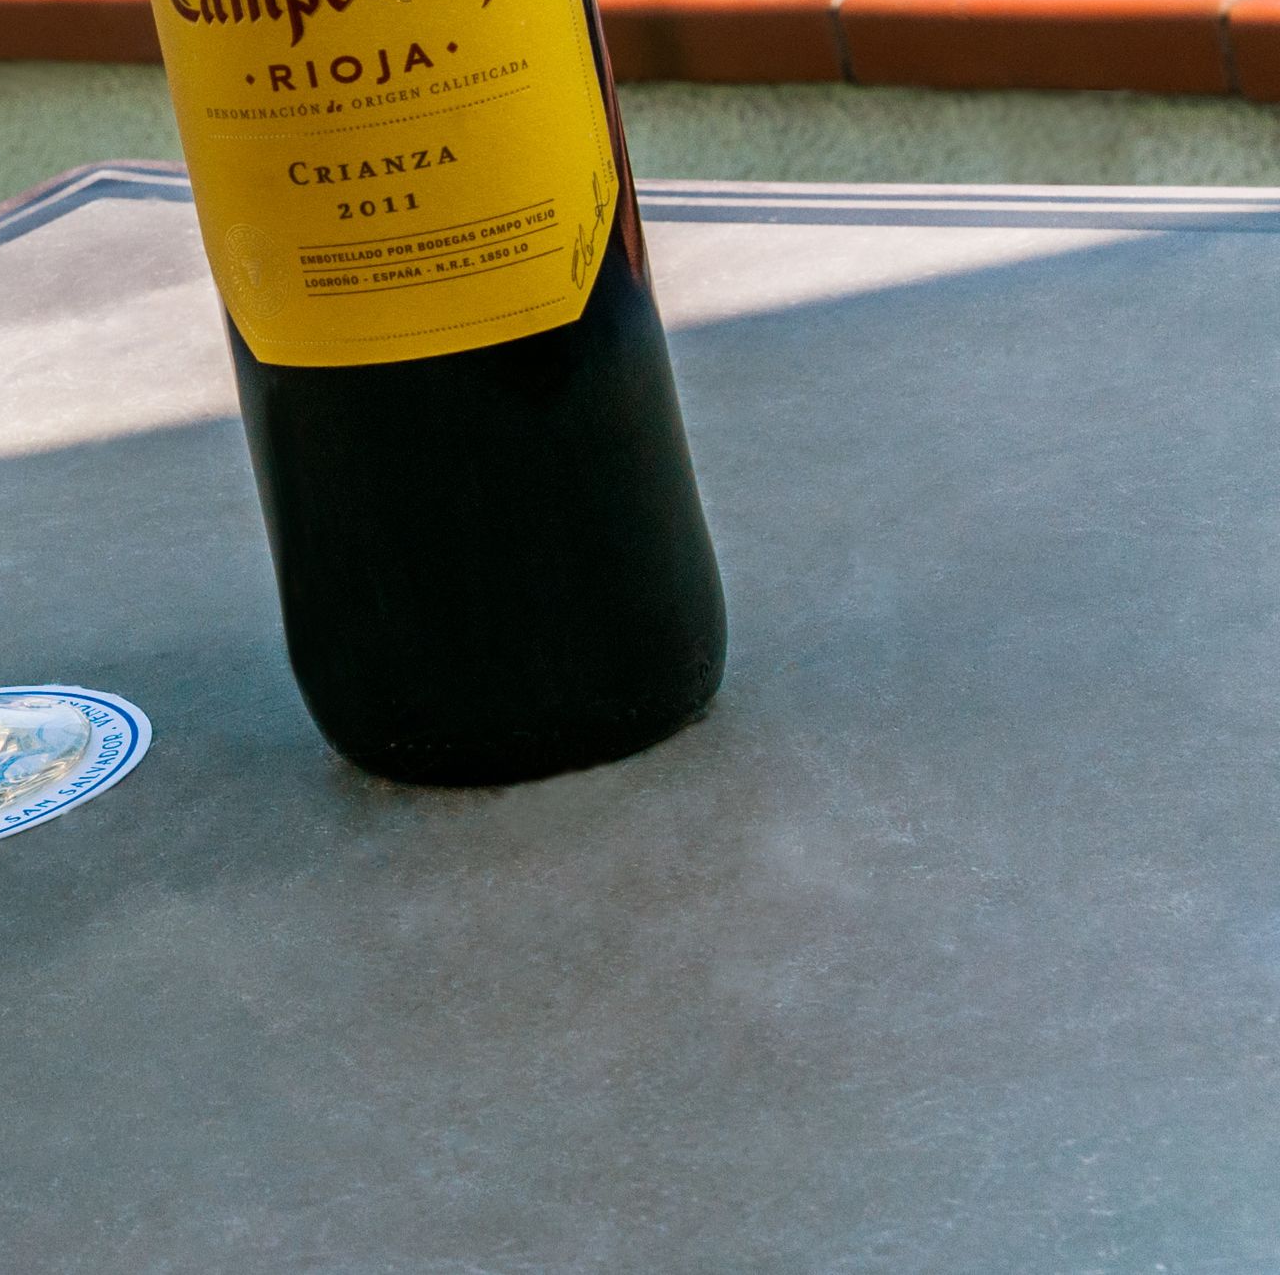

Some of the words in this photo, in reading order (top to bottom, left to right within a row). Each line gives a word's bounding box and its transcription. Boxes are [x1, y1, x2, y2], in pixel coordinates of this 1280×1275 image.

[206, 103, 321, 120] DENOMINACIÓN
[326, 99, 343, 114] de
[351, 86, 422, 111] ORIGEN
[429, 58, 529, 96] CALIFICADA
[267, 42, 435, 93] RIOJA
[288, 144, 458, 186] CRIANZA
[337, 192, 420, 220] 2011
[300, 248, 383, 265] EMBOTELLADO
[387, 244, 414, 257] POR
[417, 231, 476, 252] BODEGAS
[480, 219, 522, 238] CAMPO
[524, 208, 556, 226] VIEJO
[305, 273, 359, 288] LOGROÑO
[372, 266, 423, 283] ESPAÑA
[436, 257, 476, 272] N.R.E.
[479, 247, 511, 264] 1850
[513, 242, 530, 256] LO
[57, 731, 124, 797] SALVADOR
